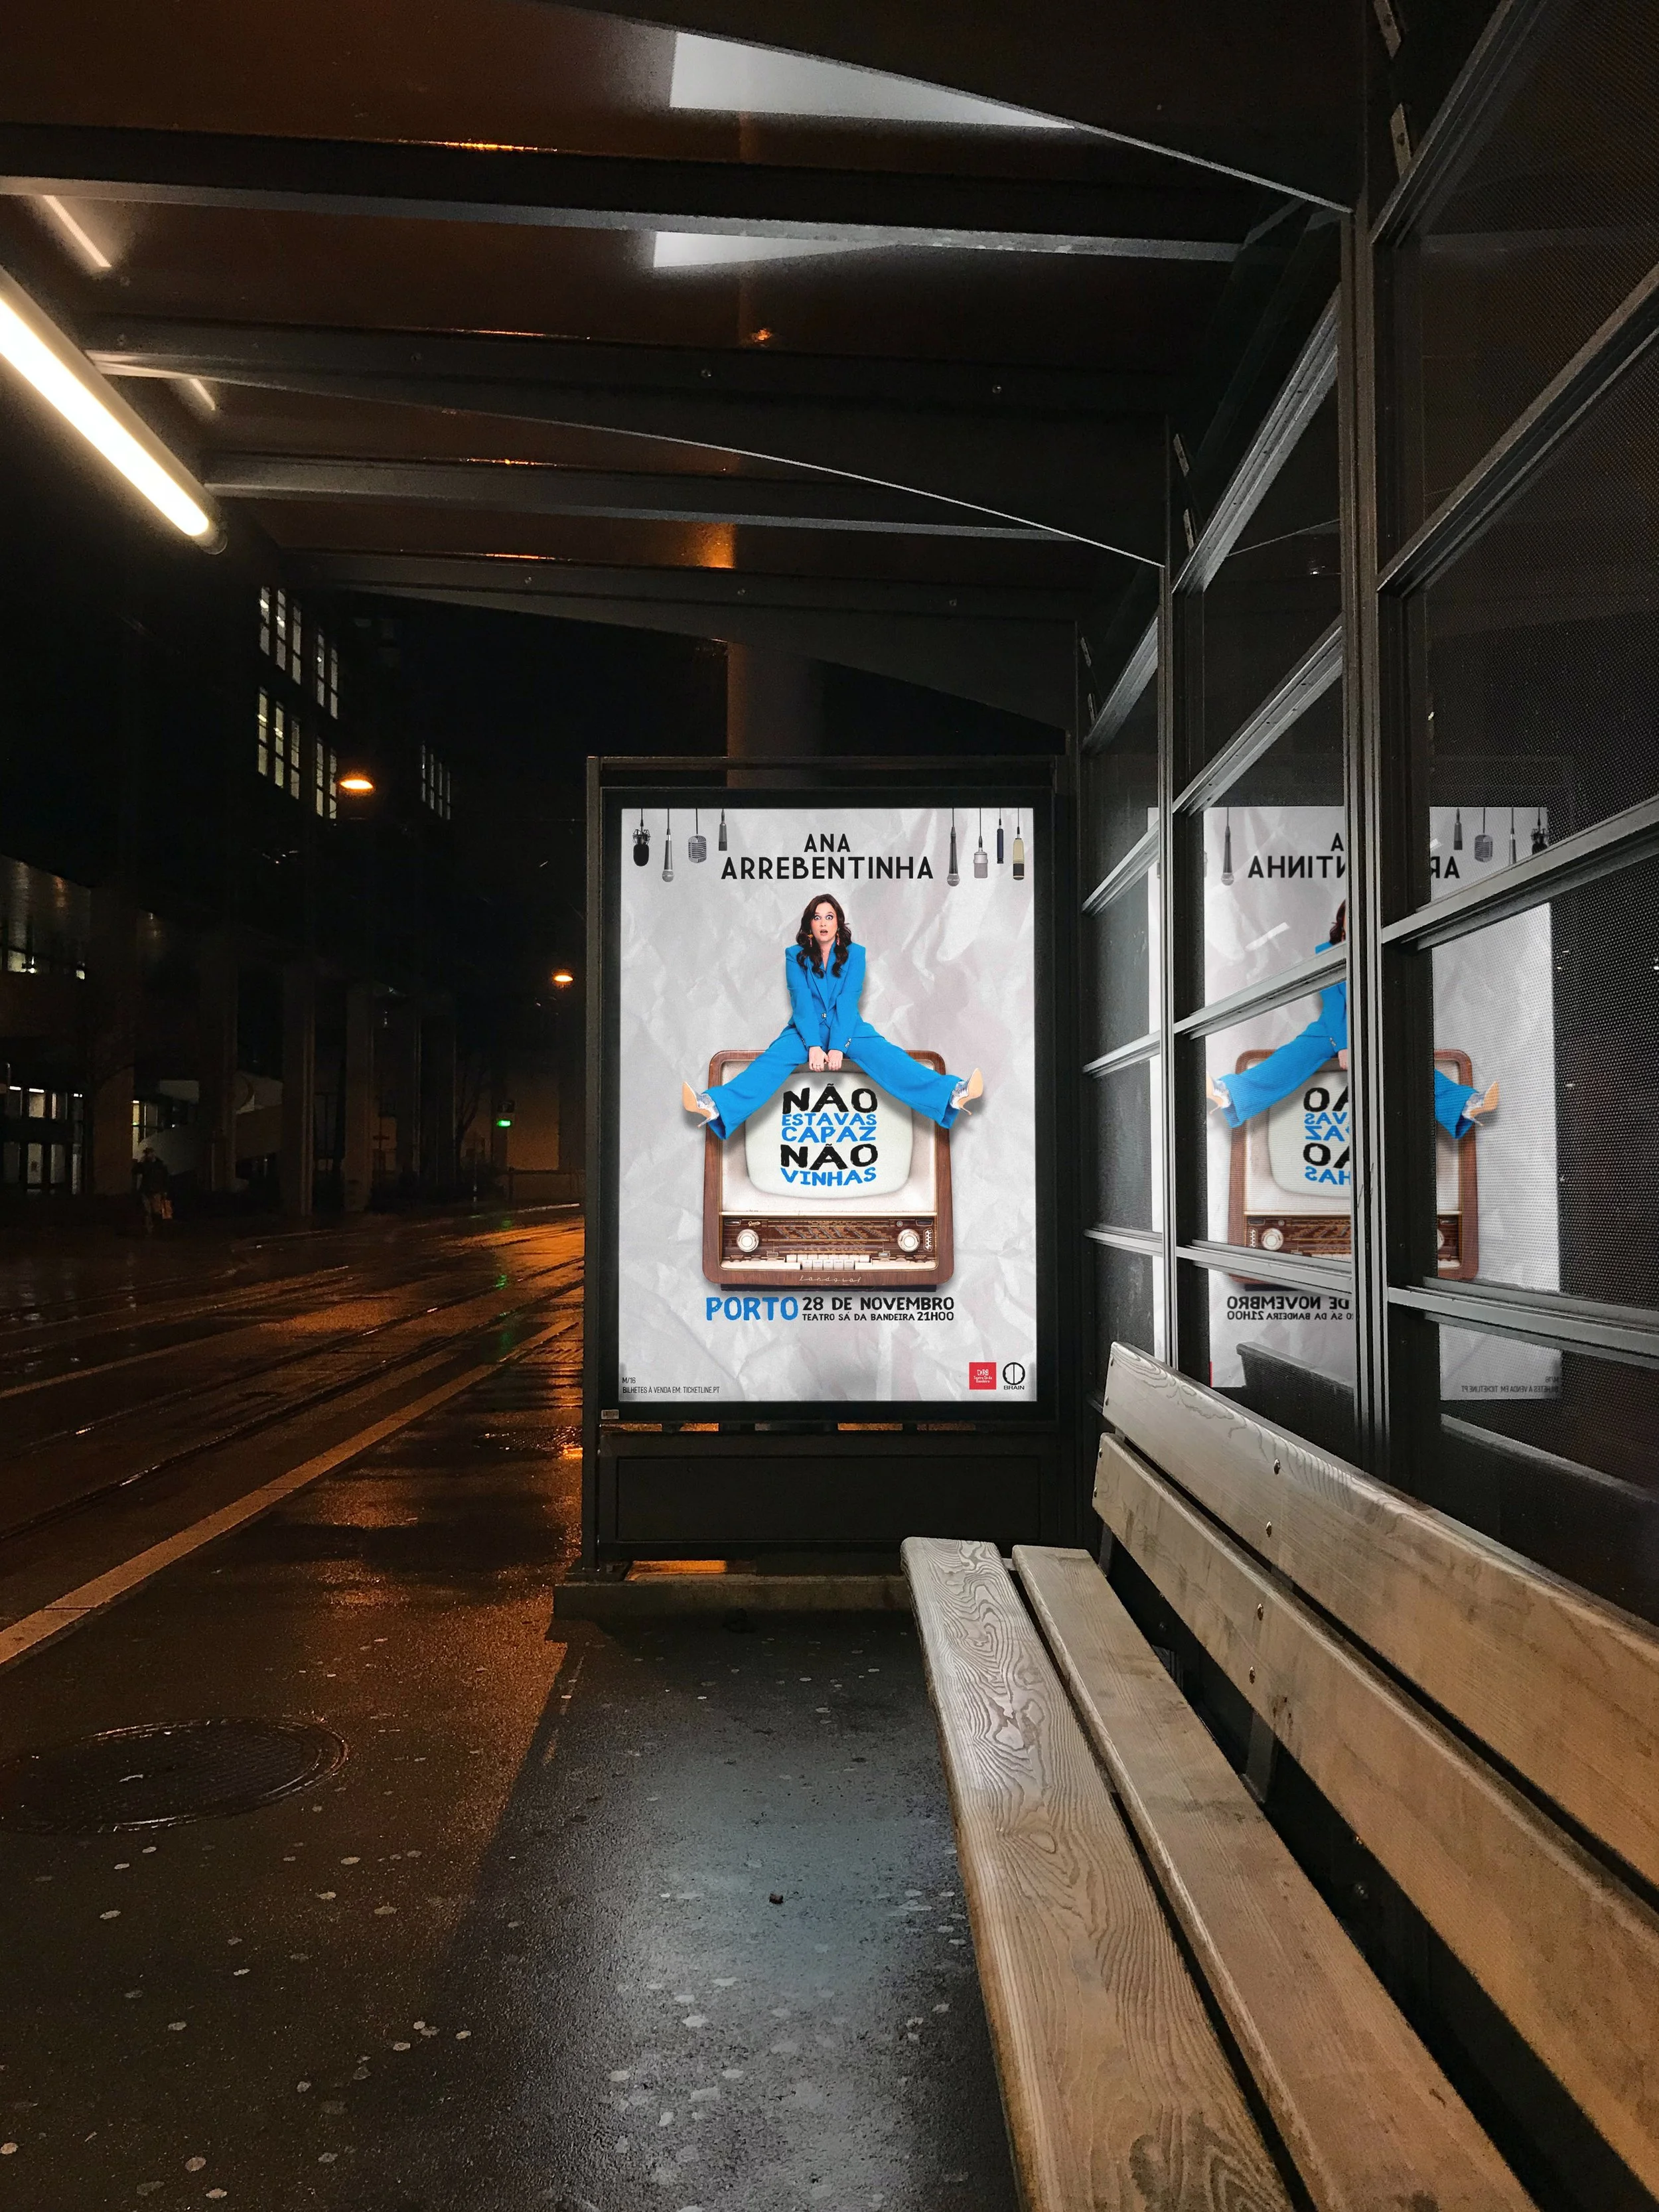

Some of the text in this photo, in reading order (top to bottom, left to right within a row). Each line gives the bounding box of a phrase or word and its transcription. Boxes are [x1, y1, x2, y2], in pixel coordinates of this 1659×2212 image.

[804, 833, 851, 853] ANA
[721, 856, 934, 880] ARREBENTINHA
[782, 1082, 879, 1114] NÃO
[781, 1112, 877, 1127] ESTAVAS
[781, 1126, 877, 1143] CAPAZ
[780, 1143, 879, 1171] NÃO
[780, 1166, 877, 1187] VINHAS
[705, 1296, 799, 1321] PORTO
[802, 1296, 955, 1311] 28 DE NOVEMBRO
[802, 1313, 835, 1321] TEATRO
[838, 1311, 851, 1321] SÁ
[853, 1313, 867, 1321] DA
[870, 1313, 916, 1321] BANDEIRA
